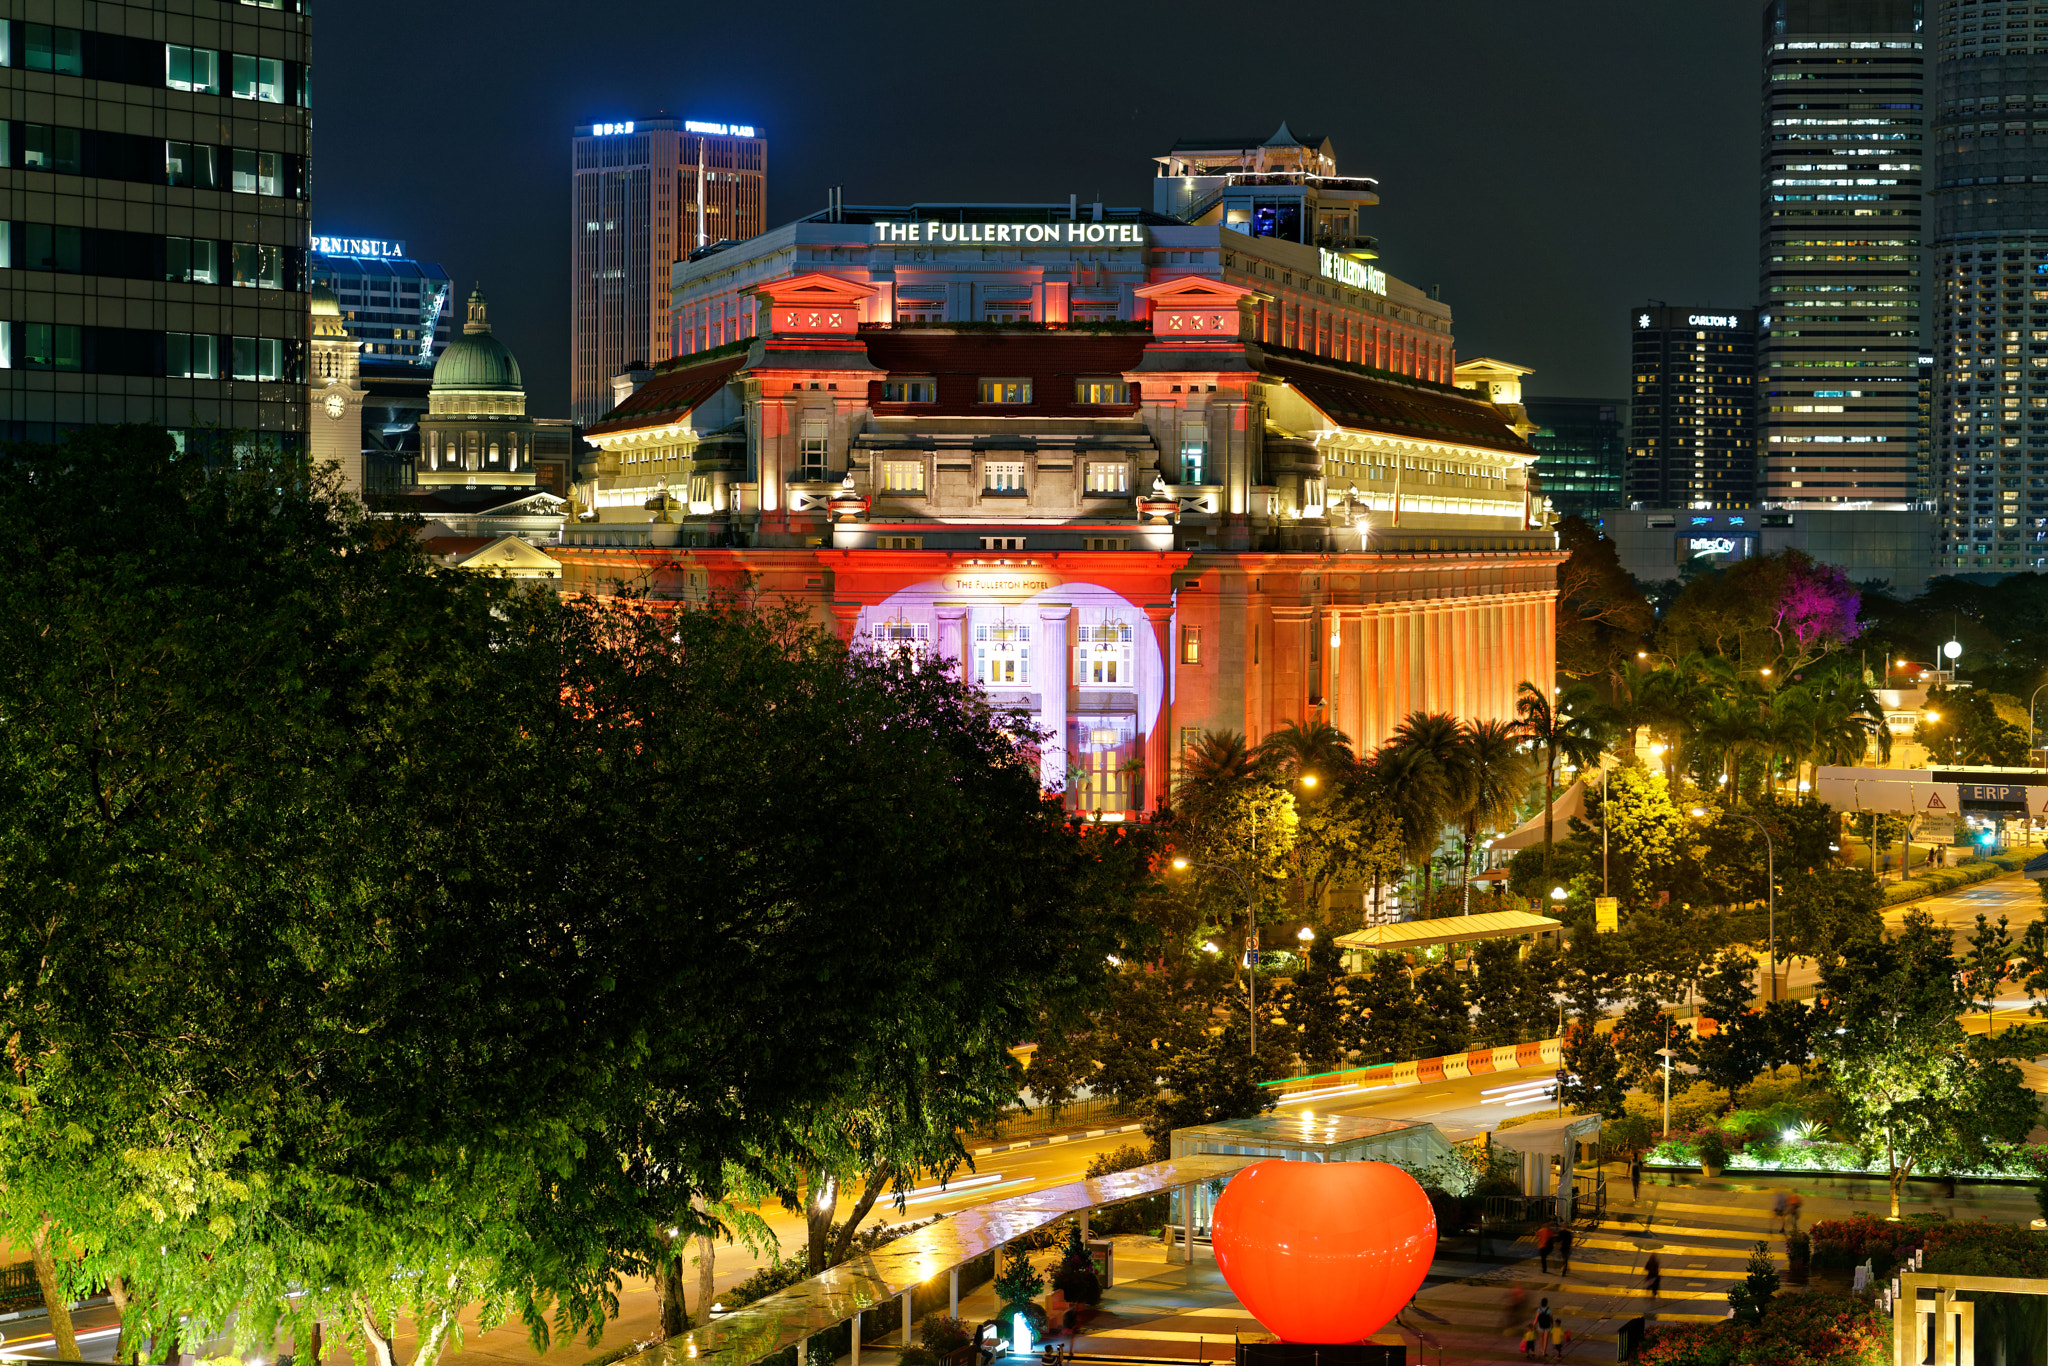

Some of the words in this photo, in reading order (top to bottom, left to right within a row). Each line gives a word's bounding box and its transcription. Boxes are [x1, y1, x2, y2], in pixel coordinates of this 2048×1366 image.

[875, 222, 919, 241] THE
[927, 222, 1060, 241] FULLERTON
[1068, 223, 1143, 242] HOTEL
[311, 237, 402, 256] PENINSULA
[1320, 247, 1332, 278] THE
[1334, 253, 1367, 290] FULLERTON
[1368, 265, 1386, 296] HOTEL
[1689, 315, 1727, 326] CARLTON
[957, 580, 972, 589] THE
[976, 580, 1020, 589] FULLERTON
[1023, 580, 1048, 589] HOTEL
[1973, 786, 2010, 800] ERP
